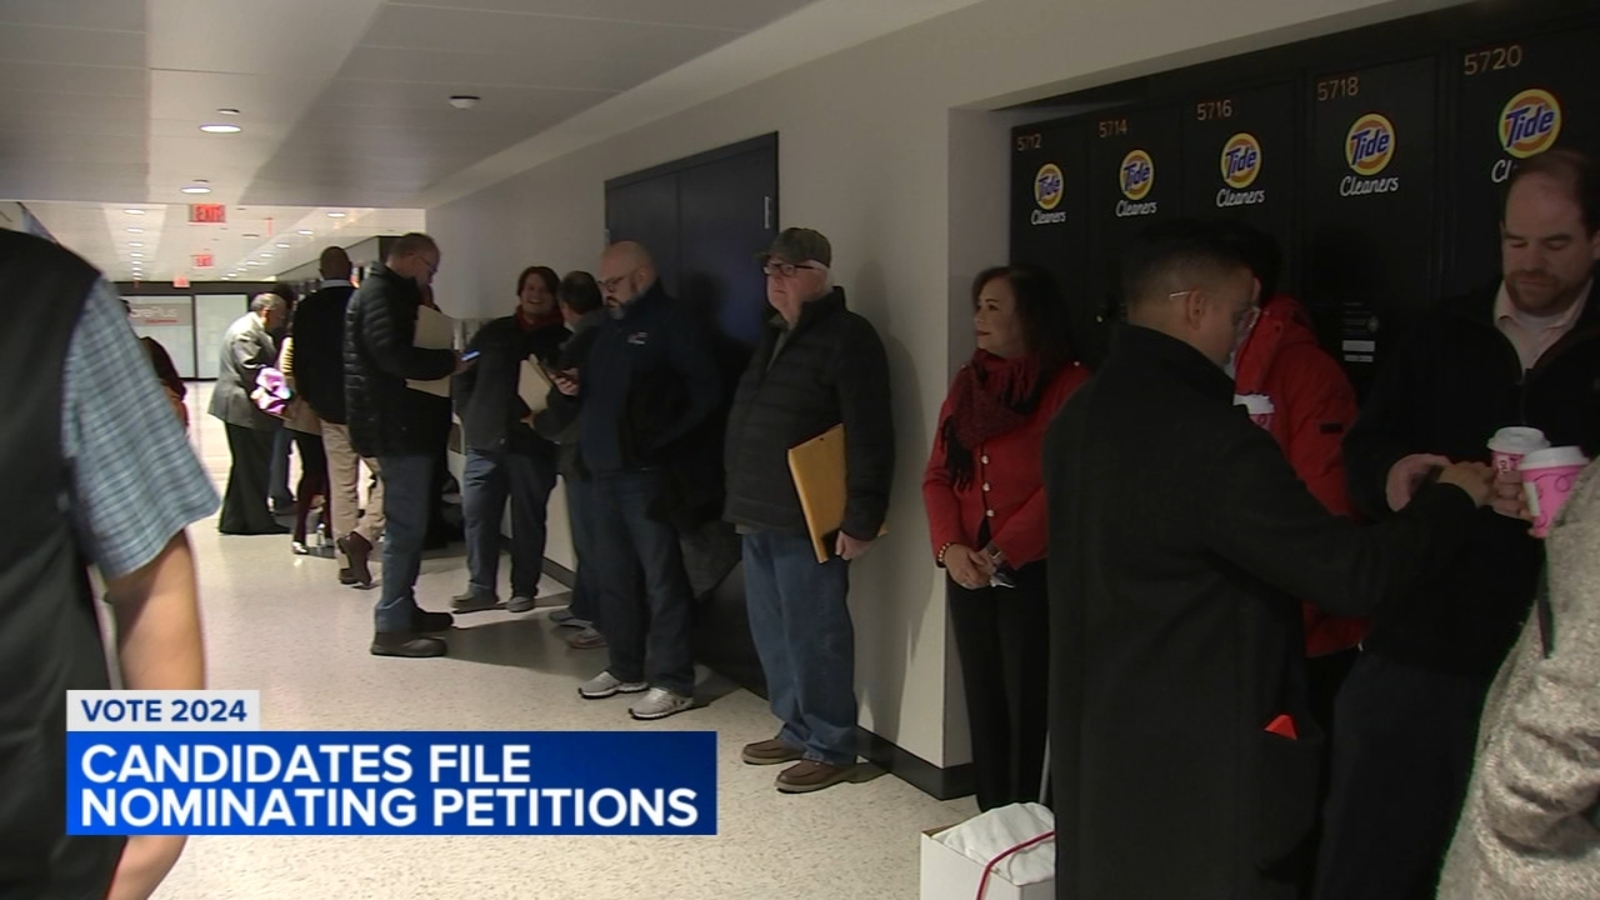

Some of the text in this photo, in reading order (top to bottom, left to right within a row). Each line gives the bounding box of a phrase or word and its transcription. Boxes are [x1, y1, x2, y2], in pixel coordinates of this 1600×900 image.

[1464, 44, 1523, 76] 5720
[1317, 76, 1360, 101] 5718
[1197, 99, 1233, 121] 5716
[1099, 119, 1128, 138] 5714
[1505, 106, 1555, 149] Tide
[1017, 133, 1042, 151] 5712
[1351, 128, 1391, 166] Tide
[1226, 146, 1258, 180] Tide
[1038, 174, 1061, 200] Tide
[1123, 162, 1151, 192] Tide
[1339, 175, 1400, 197] Cleaners
[1115, 199, 1158, 218] Cleaners
[1216, 188, 1266, 208] Cleaners
[1030, 209, 1067, 226] Cleaners
